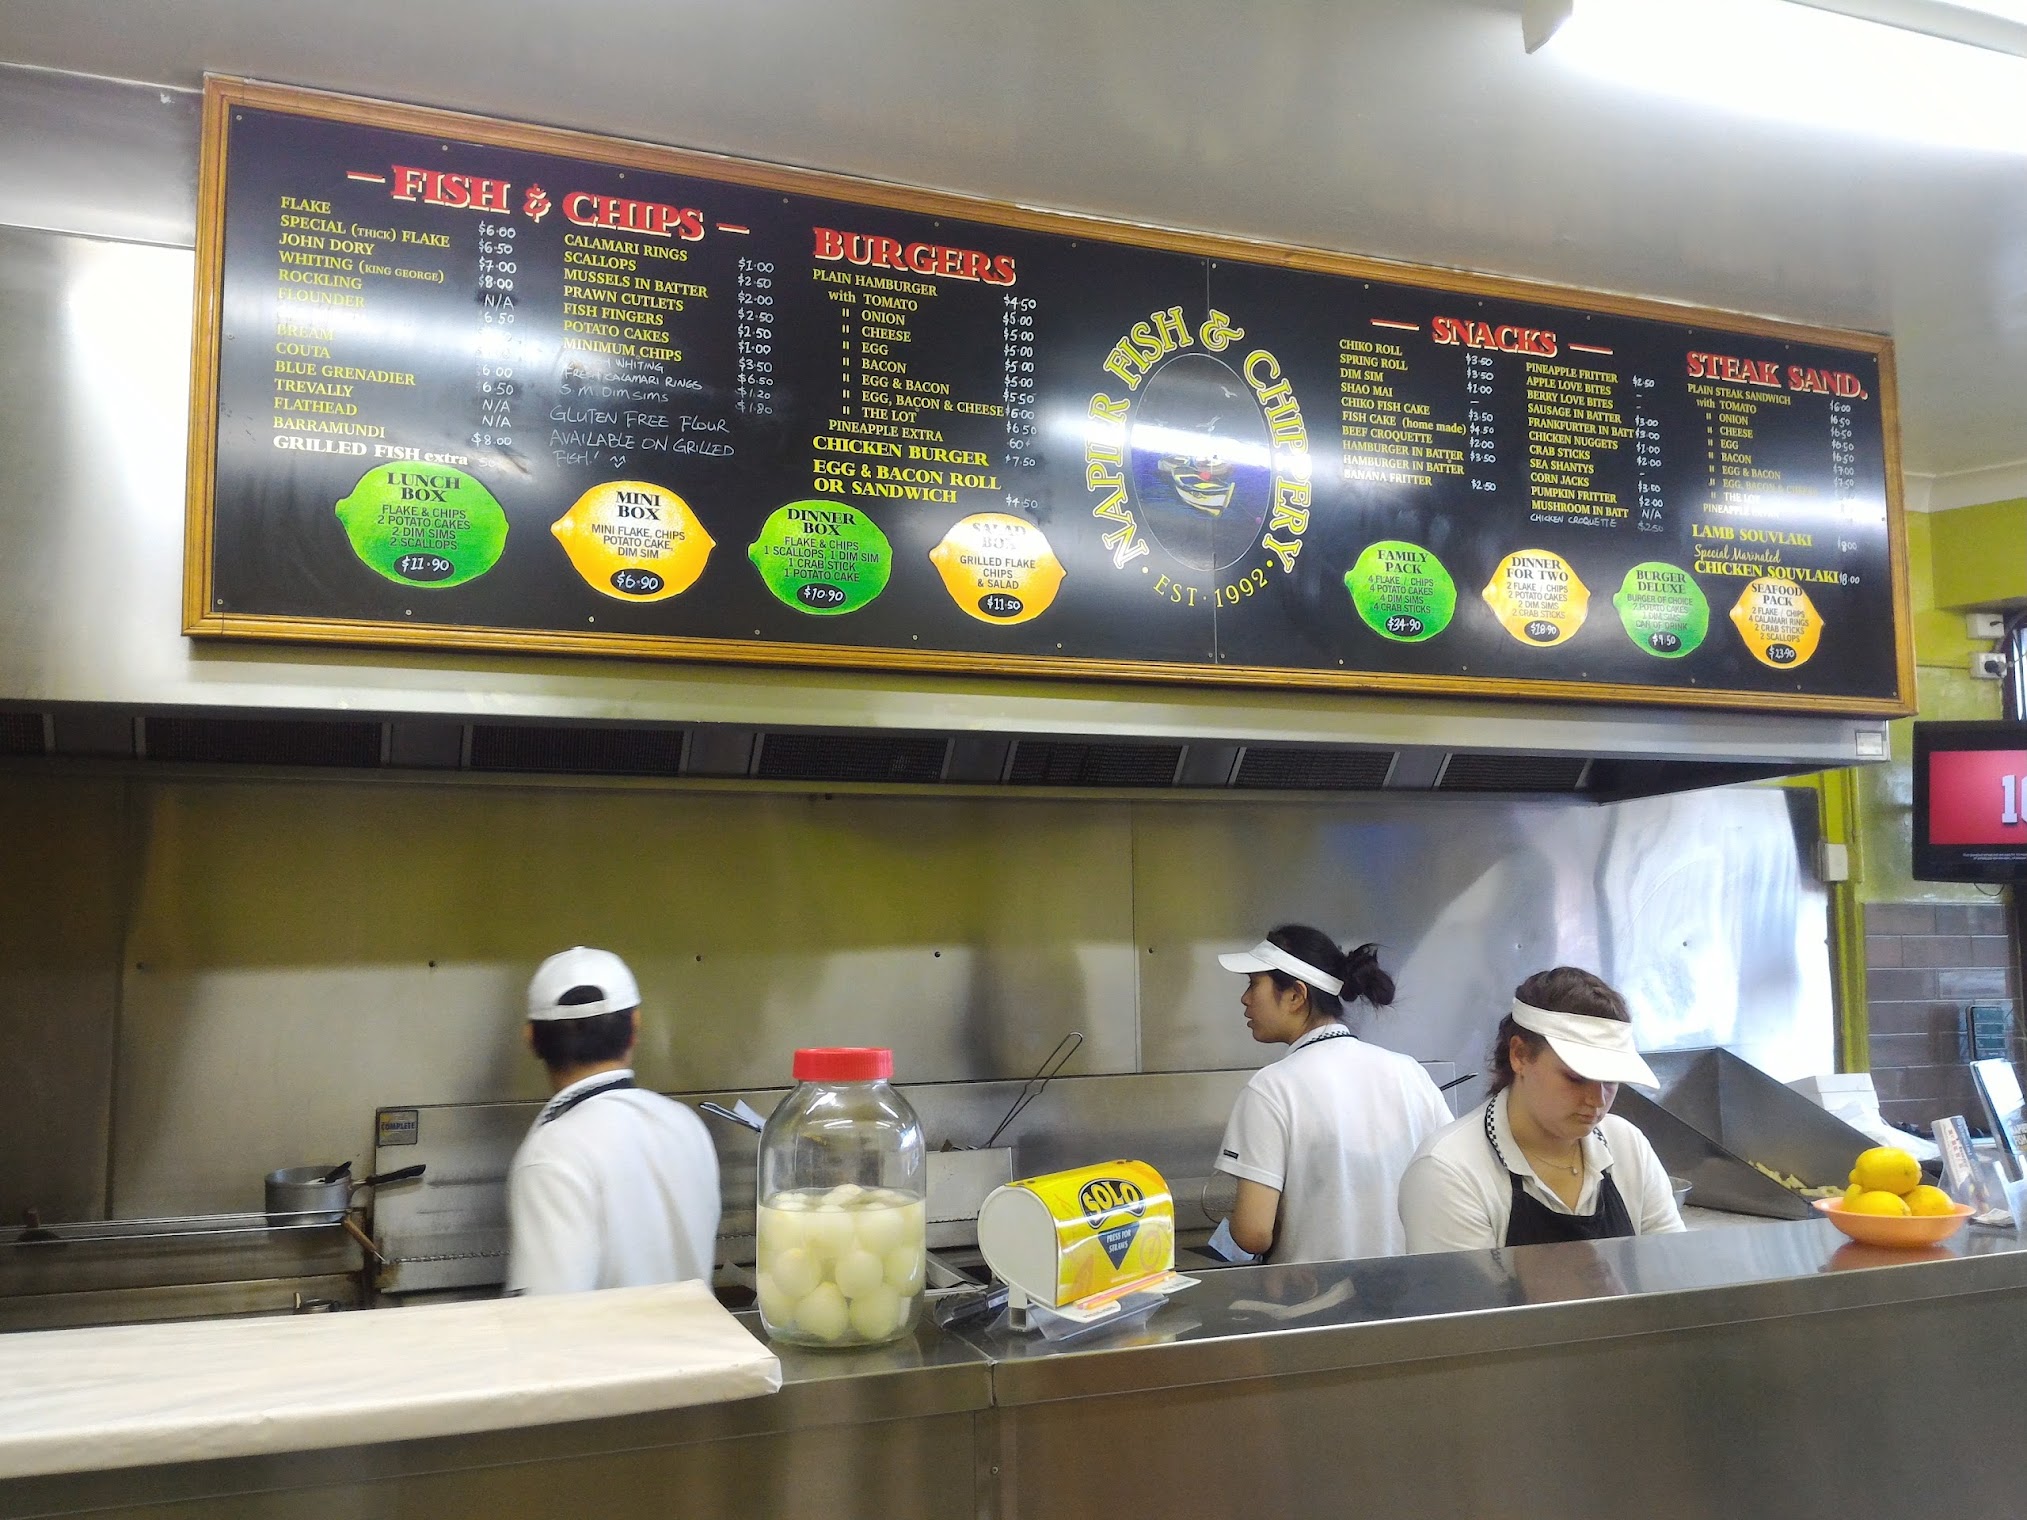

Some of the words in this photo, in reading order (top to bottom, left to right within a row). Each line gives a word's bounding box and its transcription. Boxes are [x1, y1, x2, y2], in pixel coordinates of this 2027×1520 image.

[280, 196, 331, 214] FLAKE
[390, 164, 510, 215] FISH
[523, 183, 551, 223] &
[562, 191, 705, 242] CHIPS
[280, 214, 346, 234] SPECIAL
[351, 223, 396, 242] (THICK)
[402, 230, 450, 248] FLAKE
[279, 233, 325, 250] JOHN
[330, 239, 375, 255] DORY
[564, 233, 639, 255] CALAMARI
[644, 245, 688, 261] RINGS
[564, 251, 637, 271] SCALLOPS
[813, 227, 1016, 286] BURGERS
[279, 250, 353, 271] WHITING
[394, 269, 445, 284] GEORGE)
[278, 269, 362, 289] ROCKLING
[564, 268, 631, 287] MUSSELS
[635, 278, 650, 290] IN
[655, 281, 708, 298] BATTER
[813, 268, 851, 285] PLAIN
[855, 275, 938, 297] HAMBURGER
[484, 294, 514, 310] N/A
[564, 285, 617, 305] PRAWN
[621, 293, 684, 312] CUTLETS
[829, 290, 856, 304] with
[863, 293, 918, 312] TOMATO
[564, 303, 597, 317] FISH
[602, 307, 664, 326] FINGERS
[862, 310, 905, 326] ONION
[277, 324, 335, 341] BREAM
[564, 320, 619, 337] POTATO
[624, 327, 670, 343] CAKES
[862, 326, 911, 343] CHEESE
[1200, 309, 1245, 351] &
[1431, 315, 1558, 358] SNACKS
[276, 342, 331, 359] COUTA
[563, 337, 635, 357] MINIMUM
[639, 346, 682, 362] CHIPS
[862, 341, 888, 355] EGG
[1104, 306, 1194, 391] FISH
[1339, 339, 1373, 353] CHIKO
[1376, 344, 1403, 356] ROLL
[862, 358, 907, 374] BACON
[1339, 354, 1378, 368] SPRING
[1381, 359, 1408, 371] ROLL
[275, 360, 317, 375] BLUE
[322, 365, 416, 386] GRENADIER
[1340, 368, 1362, 379] DIM
[1364, 370, 1384, 382] SIM
[1526, 362, 1577, 378] PINEAPPLE
[1579, 369, 1619, 383] FRITTER
[1686, 350, 1782, 388] STEAK
[1787, 364, 1868, 400] SAND.
[274, 378, 354, 397] TREVALLY
[1340, 382, 1370, 394] SHAO
[1373, 386, 1393, 397] MAI
[1526, 376, 1556, 389] APPLE
[1558, 380, 1583, 392] LOVE
[1586, 384, 1611, 395] BITES
[1688, 383, 1714, 396] PLAIN
[1715, 387, 1744, 400] STEAK
[1746, 391, 1791, 406] SANDWICH
[274, 397, 358, 416] FLATHEAD
[862, 407, 888, 420] THE
[892, 411, 917, 423] LOT
[1341, 396, 1374, 410] CHIKO
[1377, 401, 1401, 412] FISH
[1404, 403, 1430, 416] CAKE
[1696, 399, 1715, 409] with
[1719, 400, 1757, 414] TOMATO
[273, 417, 385, 438] BARRAMUNDI
[550, 405, 618, 425] GLUTEN
[623, 411, 670, 428] FREE
[680, 415, 730, 433] FLOUR
[1719, 414, 1749, 425] ONION
[829, 419, 899, 437] PINEAPPLE
[902, 428, 944, 442] EXTRA
[1342, 425, 1368, 437] BEEF
[1370, 428, 1433, 444] CROQUETTE
[1719, 427, 1754, 439] CHEESE
[550, 429, 634, 449] AVAILABLE
[641, 436, 669, 451] ON
[673, 438, 735, 457] GRILLED
[1529, 431, 1572, 445] CHICKEN
[1574, 436, 1619, 450] NUGGETS
[1720, 440, 1739, 450] EGG
[273, 435, 367, 456] GRILLED
[374, 445, 420, 461] FISH
[425, 451, 468, 465] extra
[813, 436, 902, 458] CHICKEN
[909, 445, 990, 466] BURGER
[1529, 445, 1556, 457] CRAB
[1558, 448, 1591, 460] STICKS
[1721, 453, 1752, 464] BACON
[813, 459, 856, 477] EGG
[860, 464, 871, 478] &
[876, 466, 943, 485] BACON
[950, 473, 1002, 490] ROLL
[1530, 459, 1549, 470] SEA
[1551, 461, 1594, 474] SHANTYS
[387, 472, 461, 489] LUNCH
[1085, 392, 1149, 570] NAPIR
[1530, 473, 1558, 485] CORN
[1560, 475, 1590, 488] JACKS
[401, 487, 447, 502] BOX
[616, 491, 660, 507] MINI
[814, 478, 845, 494] OR
[851, 481, 957, 503] SANDWICH
[1531, 486, 1575, 500] PUMPKIN
[1577, 491, 1617, 504] FRITTER
[382, 505, 418, 516] FLAKE
[421, 508, 430, 517] &
[432, 508, 466, 519] CHIPS
[618, 505, 660, 521] BOX
[787, 508, 856, 526] DINNER
[1642, 509, 1662, 520] N/A
[377, 515, 385, 525] 2
[388, 516, 432, 527] POTATO
[434, 519, 471, 530] CAKES
[803, 522, 841, 536] BOX
[1692, 524, 1735, 540] LAMB
[1739, 529, 1813, 547] SOUVLAKI
[618, 546, 638, 557] DIM
[640, 548, 659, 559] SIM
[1378, 550, 1428, 562] FAMILY
[1694, 544, 1729, 563] Special
[1731, 548, 1781, 563] Marinated
[960, 555, 1002, 567] GRILLED
[1005, 558, 1036, 569] FLAKE
[1385, 562, 1422, 574] PACK
[1512, 557, 1561, 570] DINNER
[1506, 568, 1535, 579] FOR
[1539, 570, 1568, 582] TWO
[1636, 570, 1686, 583] BURGER
[1694, 561, 1763, 577] CHICKEN
[1767, 566, 1839, 584] SOUVLAKI
[1214, 567, 1268, 608] 1992
[1637, 581, 1686, 594] DELUXE
[1751, 582, 1803, 596] SEAFOOD
[1763, 594, 1792, 607] PACK
[381, 1122, 415, 1130] COMPLETE
[1083, 1182, 1140, 1214] SOLO
[1106, 1232, 1120, 1243] PRESS
[1122, 1229, 1131, 1238] FOR
